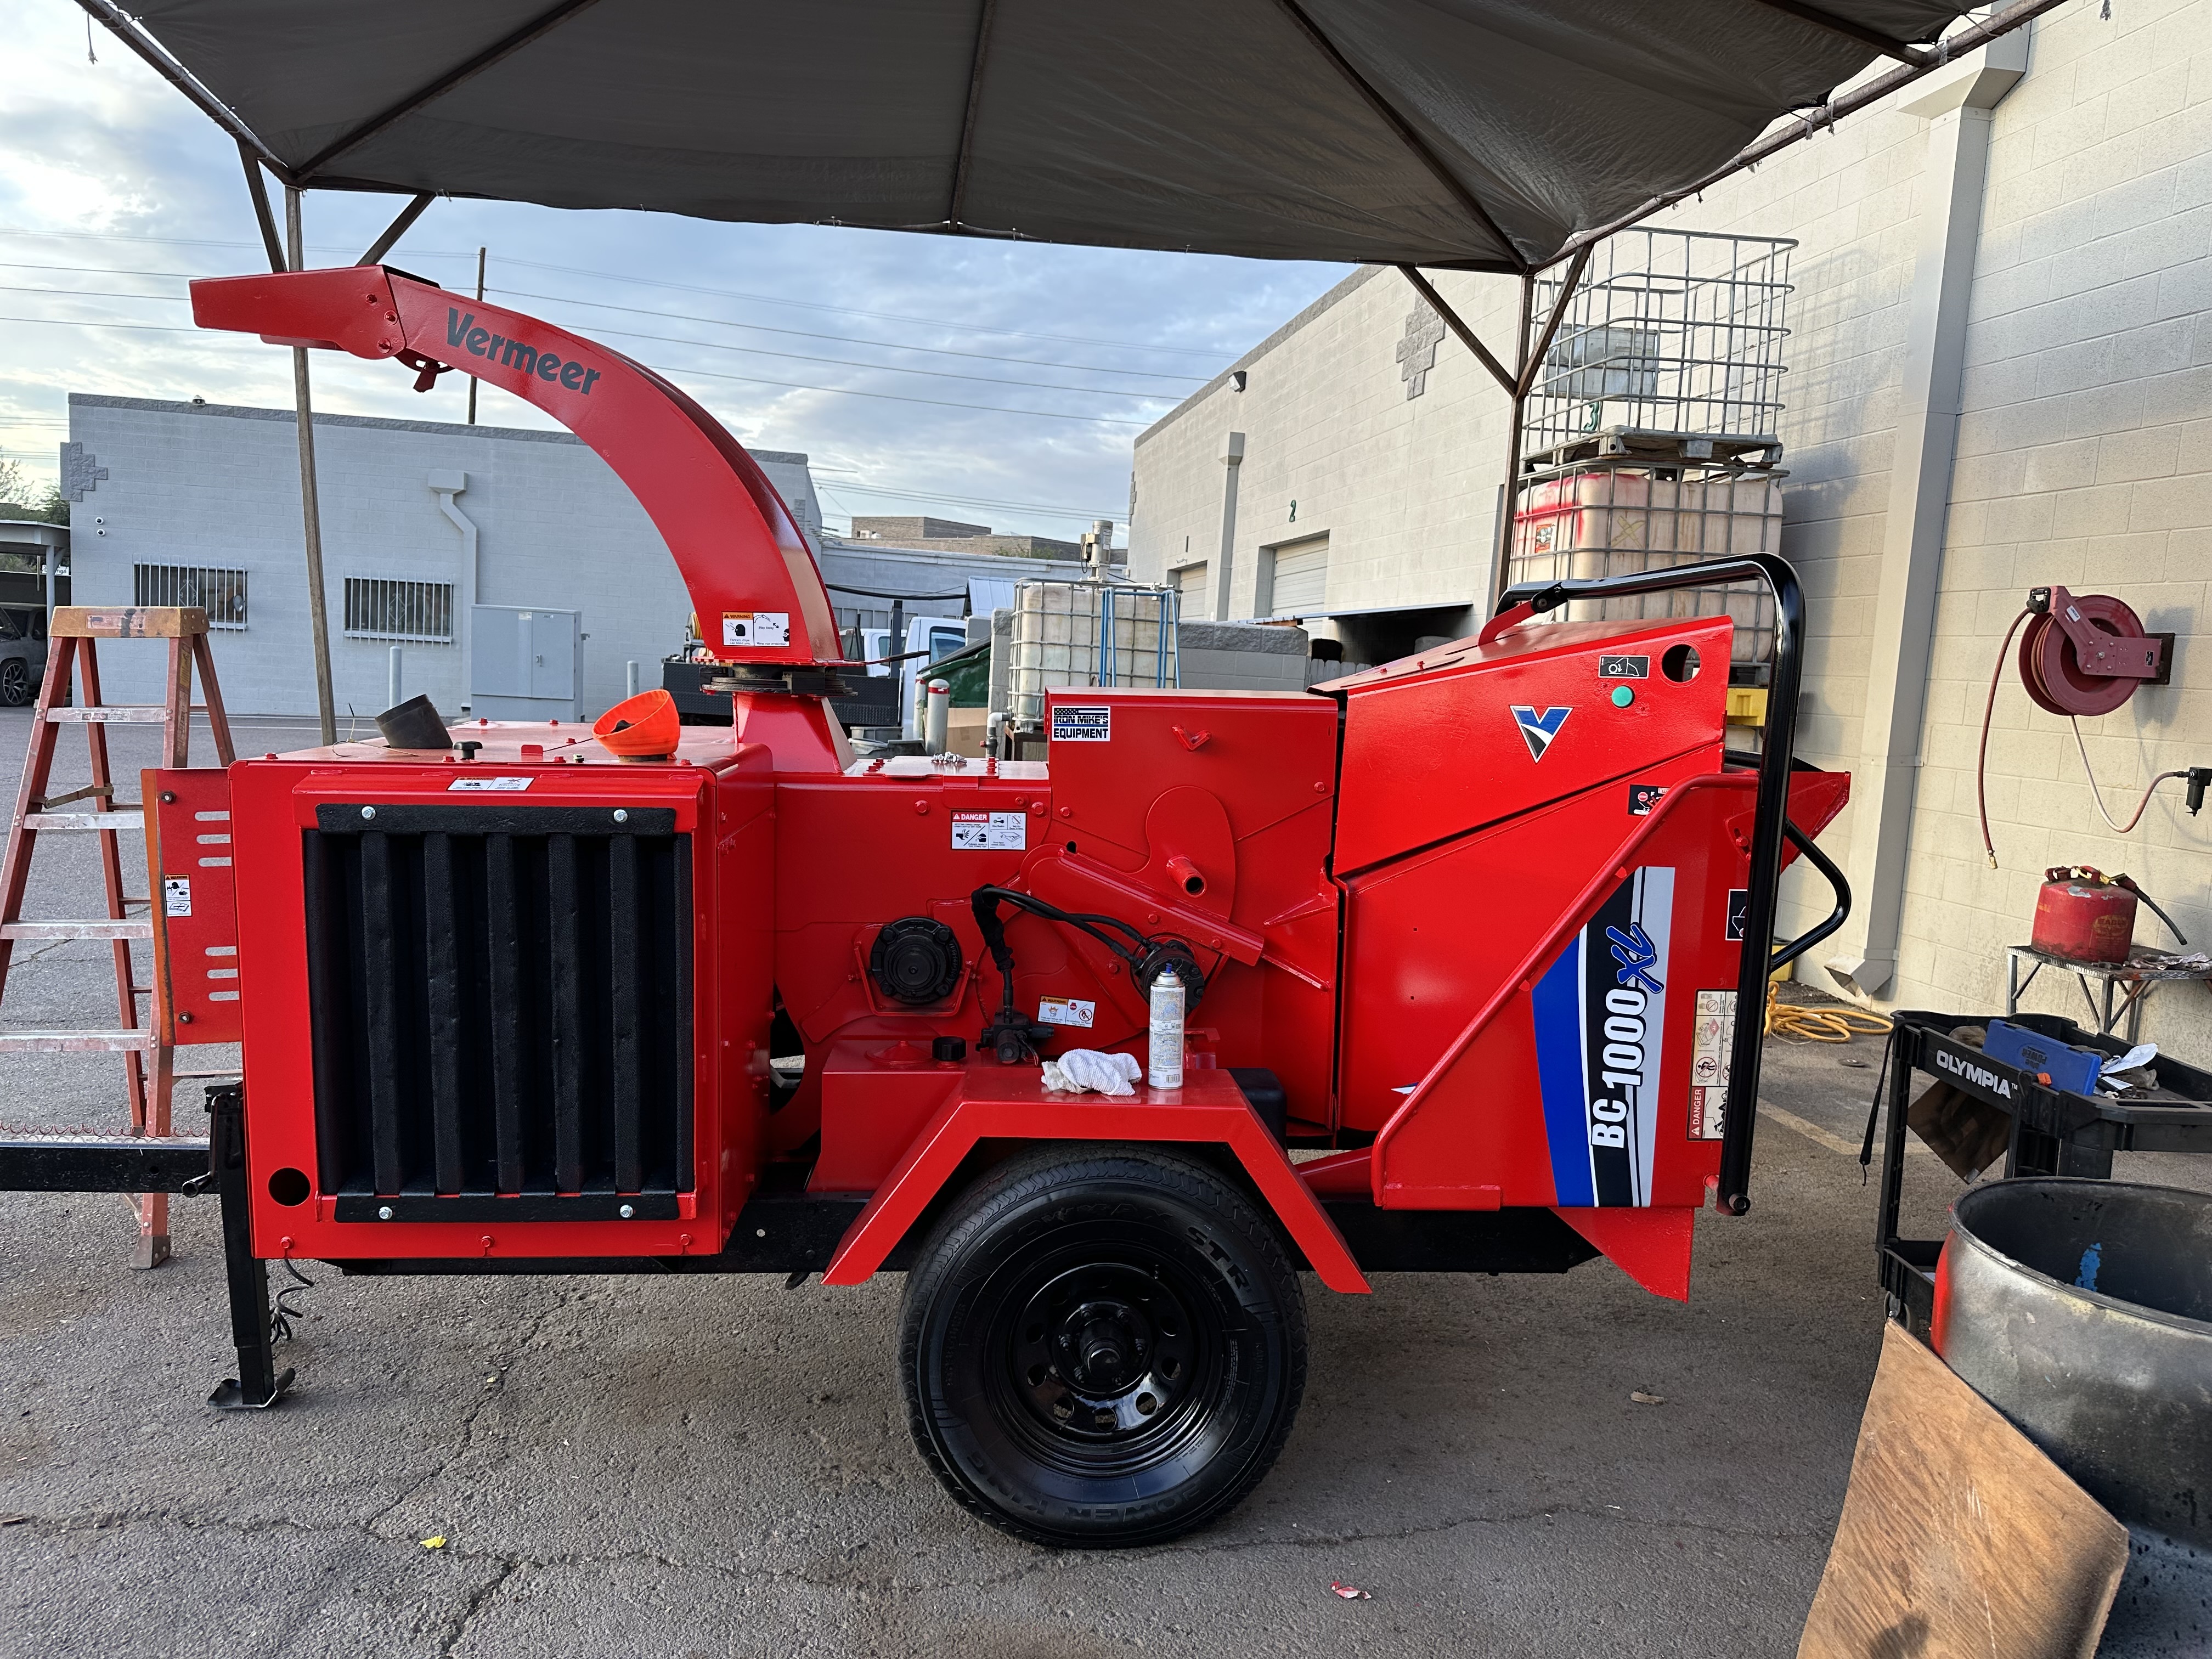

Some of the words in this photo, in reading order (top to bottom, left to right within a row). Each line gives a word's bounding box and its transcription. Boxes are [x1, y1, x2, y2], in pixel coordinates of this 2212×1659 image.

[447, 307, 601, 395] Vermeer
[1289, 499, 1296, 523] 2
[1054, 715, 1075, 724] IRON
[1077, 715, 1109, 724] MIKE'S
[1054, 728, 1108, 739] EQUIPMENT
[1606, 922, 1664, 994] XL
[1602, 988, 1647, 1089] 1000
[1936, 1049, 2011, 1099] OLYMPIA
[1592, 1099, 1628, 1148] BC
[1692, 1089, 1702, 1125] DANGER
